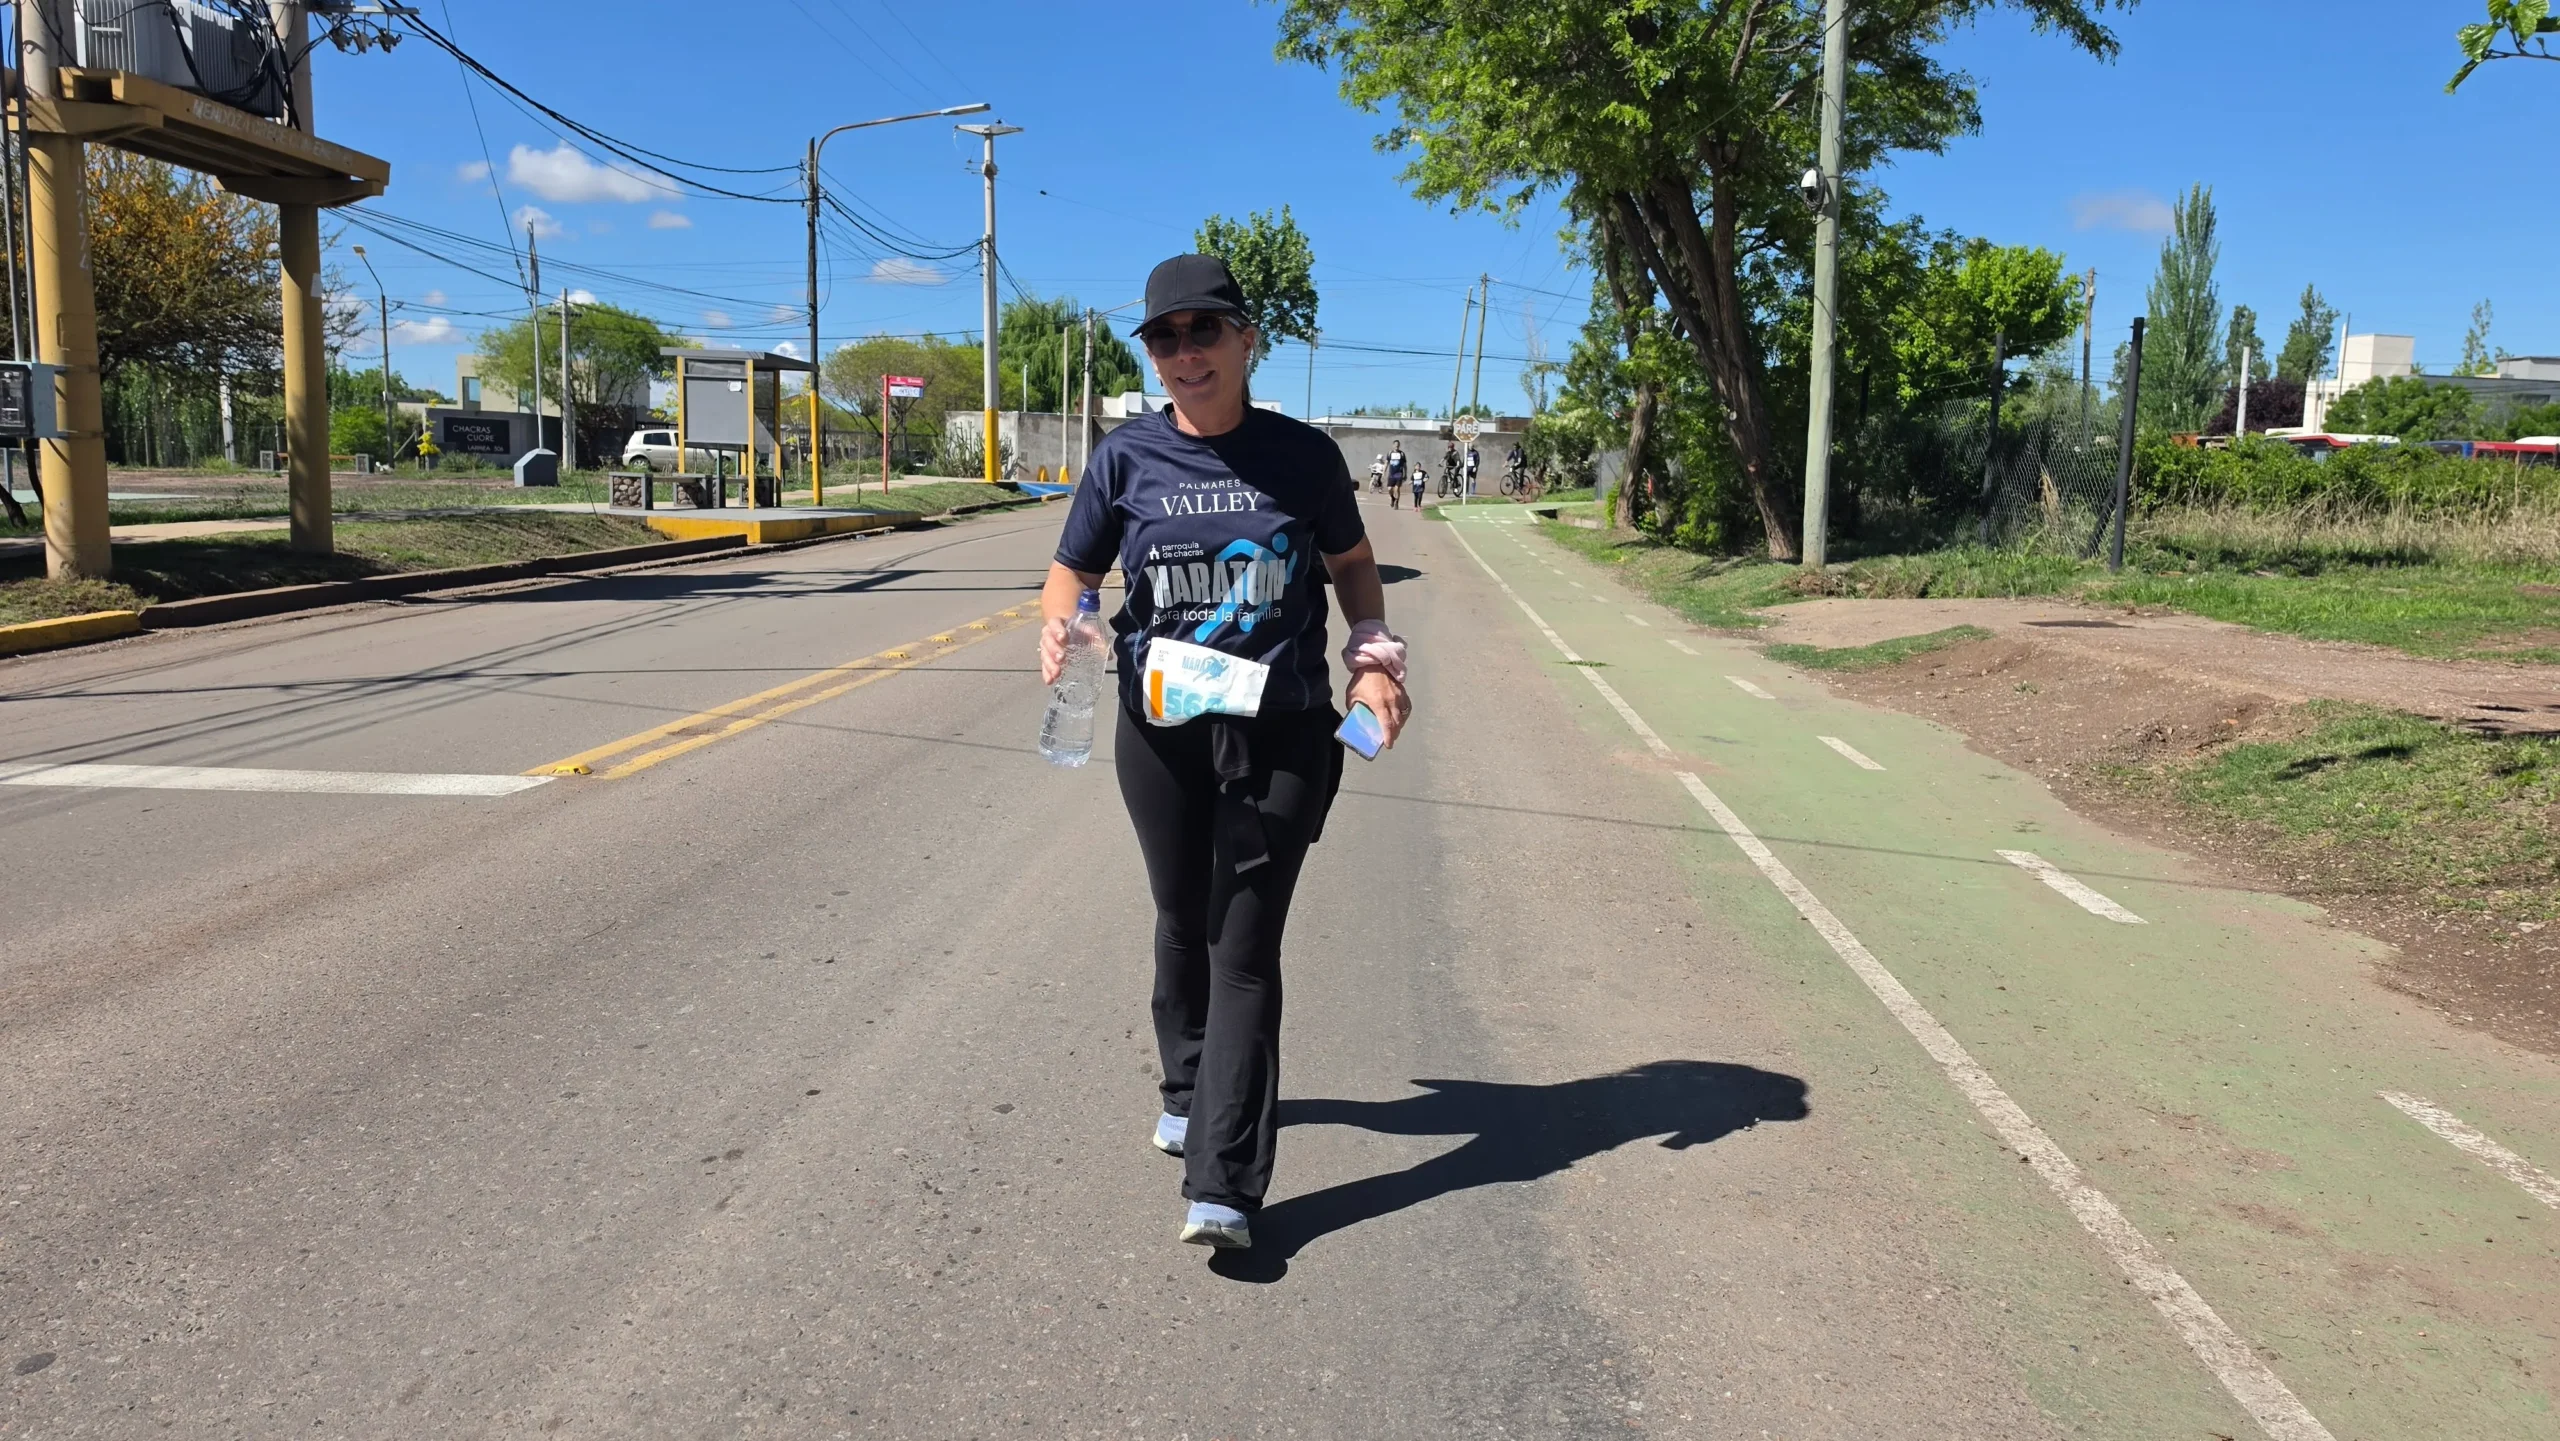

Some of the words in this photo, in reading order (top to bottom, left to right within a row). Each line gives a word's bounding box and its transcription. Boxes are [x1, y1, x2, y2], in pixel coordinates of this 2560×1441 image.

[452, 425, 491, 433] CHACRAS
[1455, 423, 1479, 434] PARE
[467, 434, 494, 442] CUORE
[1179, 478, 1242, 490] PALMARES
[1160, 491, 1262, 517] VALLEY
[1161, 540, 1200, 553] parroquia
[1162, 551, 1173, 559] de
[1173, 549, 1204, 558] chacras
[1144, 548, 1286, 608] MARATÓN
[1152, 609, 1180, 627] para
[1183, 607, 1217, 621] toda
[1221, 607, 1234, 622] la
[1237, 605, 1282, 623] familia
